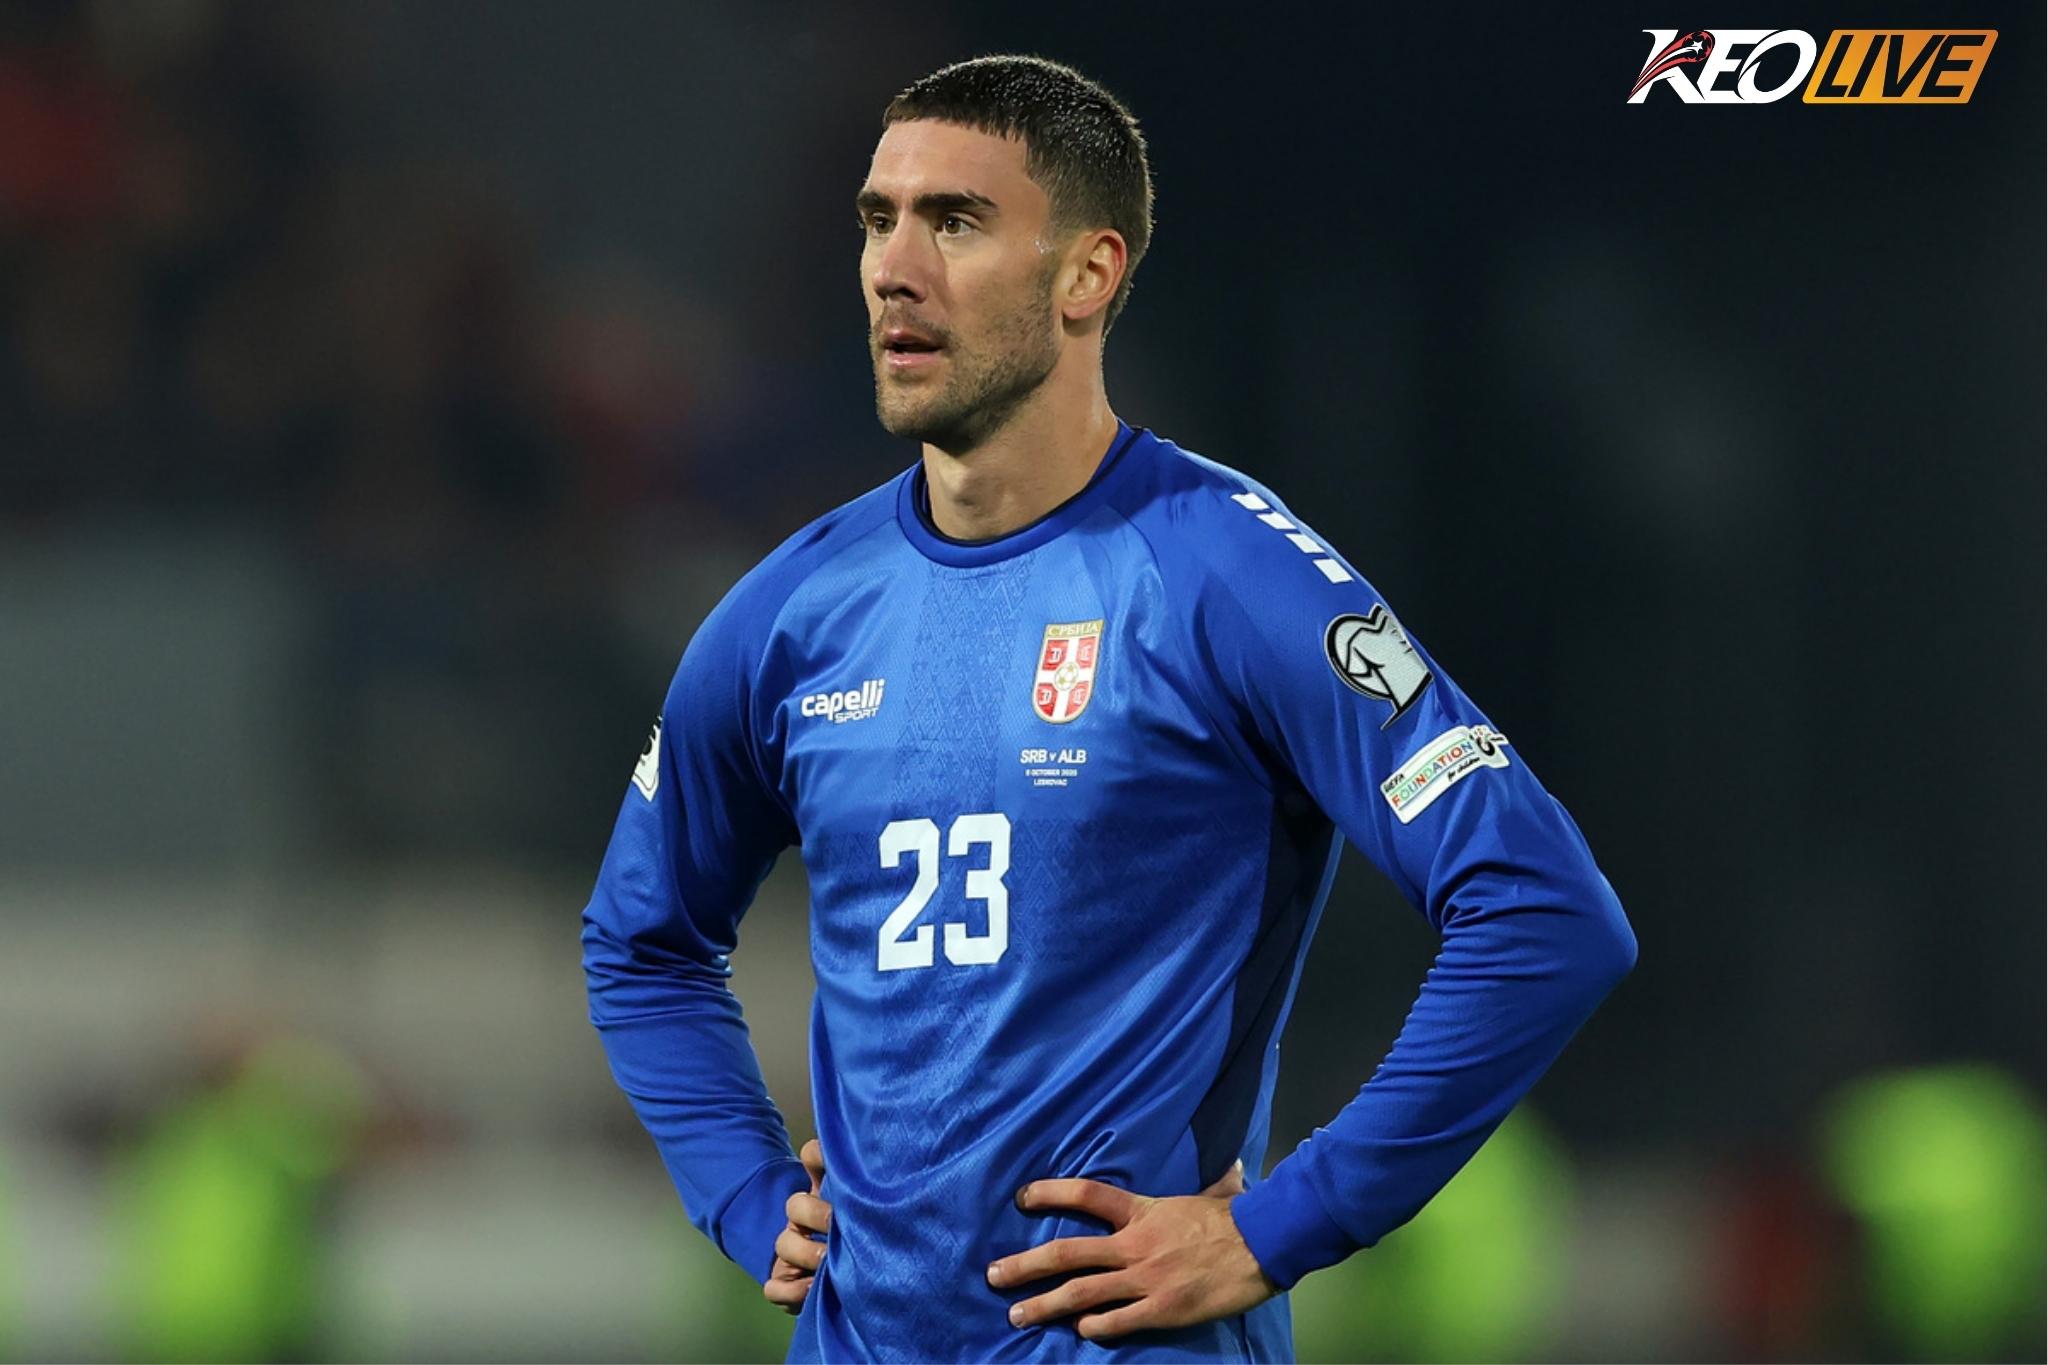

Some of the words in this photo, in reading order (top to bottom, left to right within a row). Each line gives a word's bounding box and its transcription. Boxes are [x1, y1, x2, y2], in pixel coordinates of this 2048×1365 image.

[802, 679, 885, 720] capelli
[834, 707, 879, 724] SPORT
[1020, 749, 1047, 764] SRB
[1057, 749, 1087, 764] ALB
[1392, 741, 1474, 807] FOUNDATION
[878, 813, 1011, 972] 23
